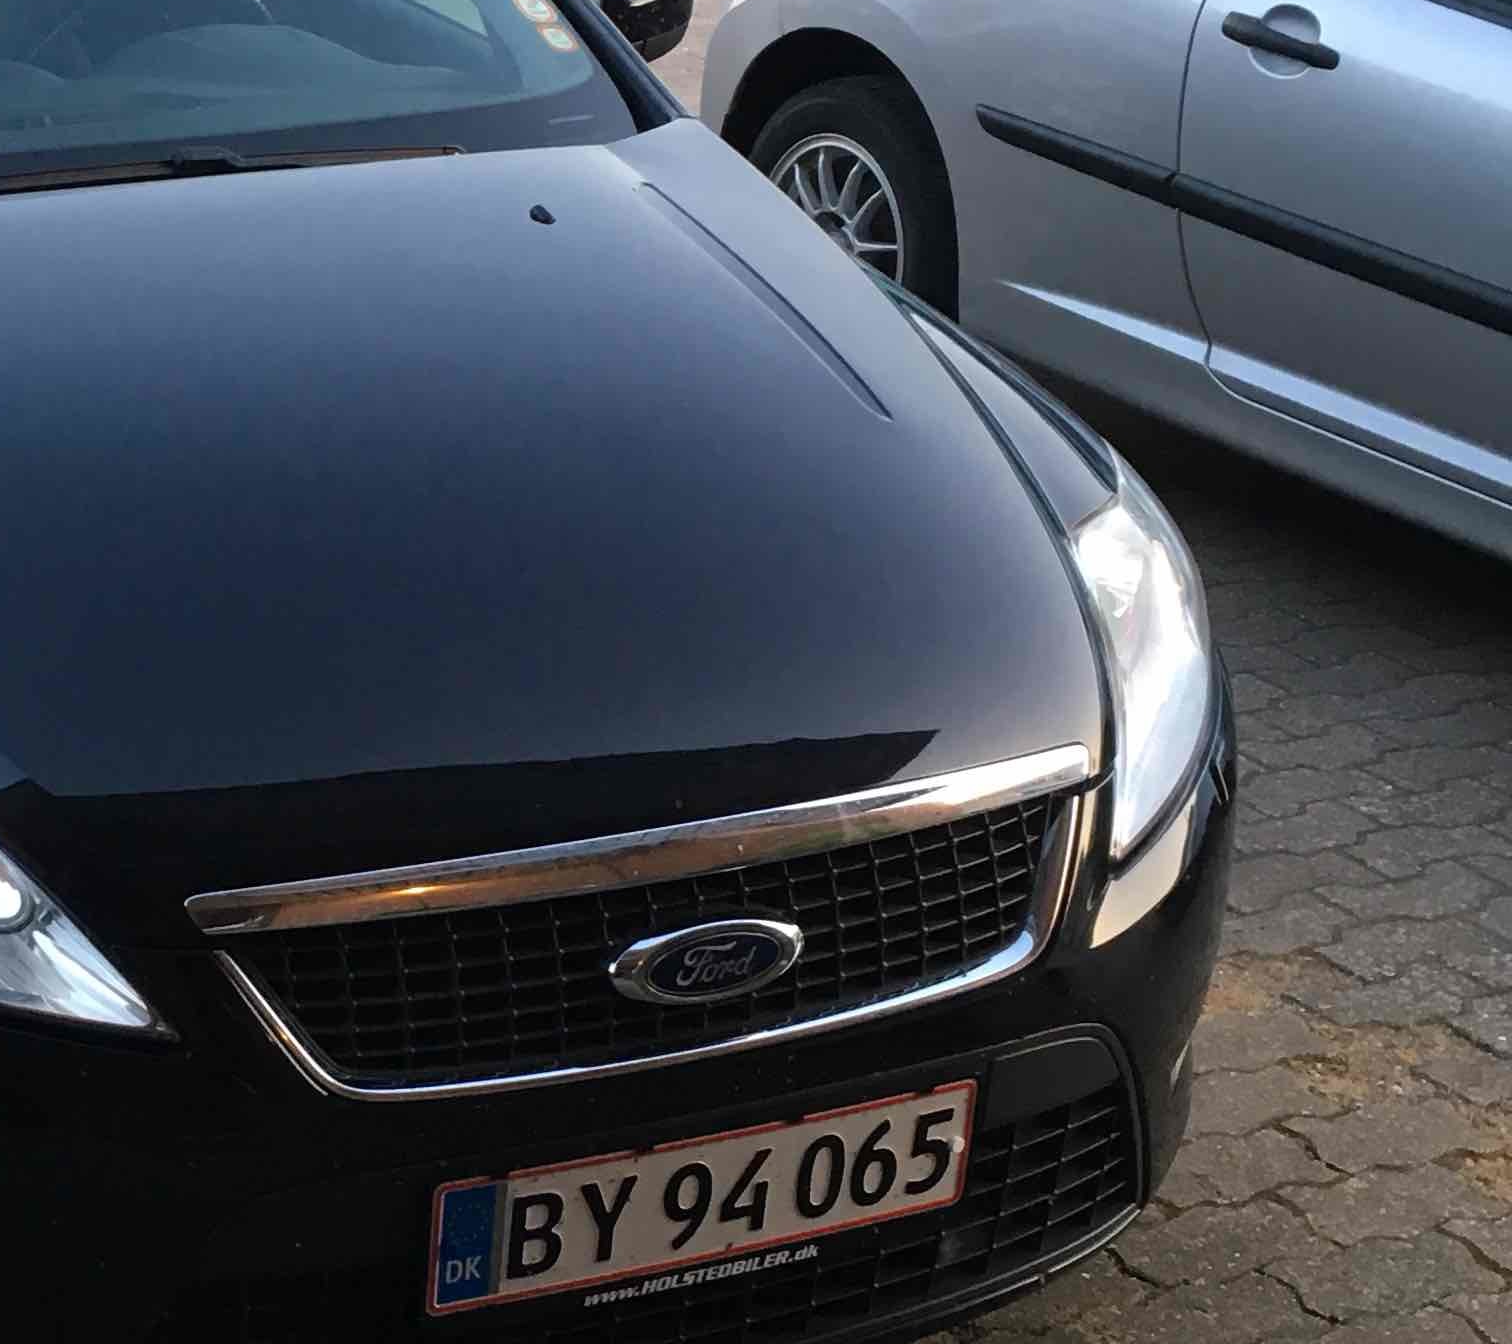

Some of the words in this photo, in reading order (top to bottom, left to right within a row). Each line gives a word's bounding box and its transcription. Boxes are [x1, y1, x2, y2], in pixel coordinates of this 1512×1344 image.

[675, 940, 758, 987] Ford
[506, 1174, 638, 1280] BY
[663, 1147, 773, 1251] 94
[796, 1107, 955, 1219] 065
[445, 1256, 483, 1284] DK
[584, 1244, 820, 1307] www.HOLSTEDBILER.dk
